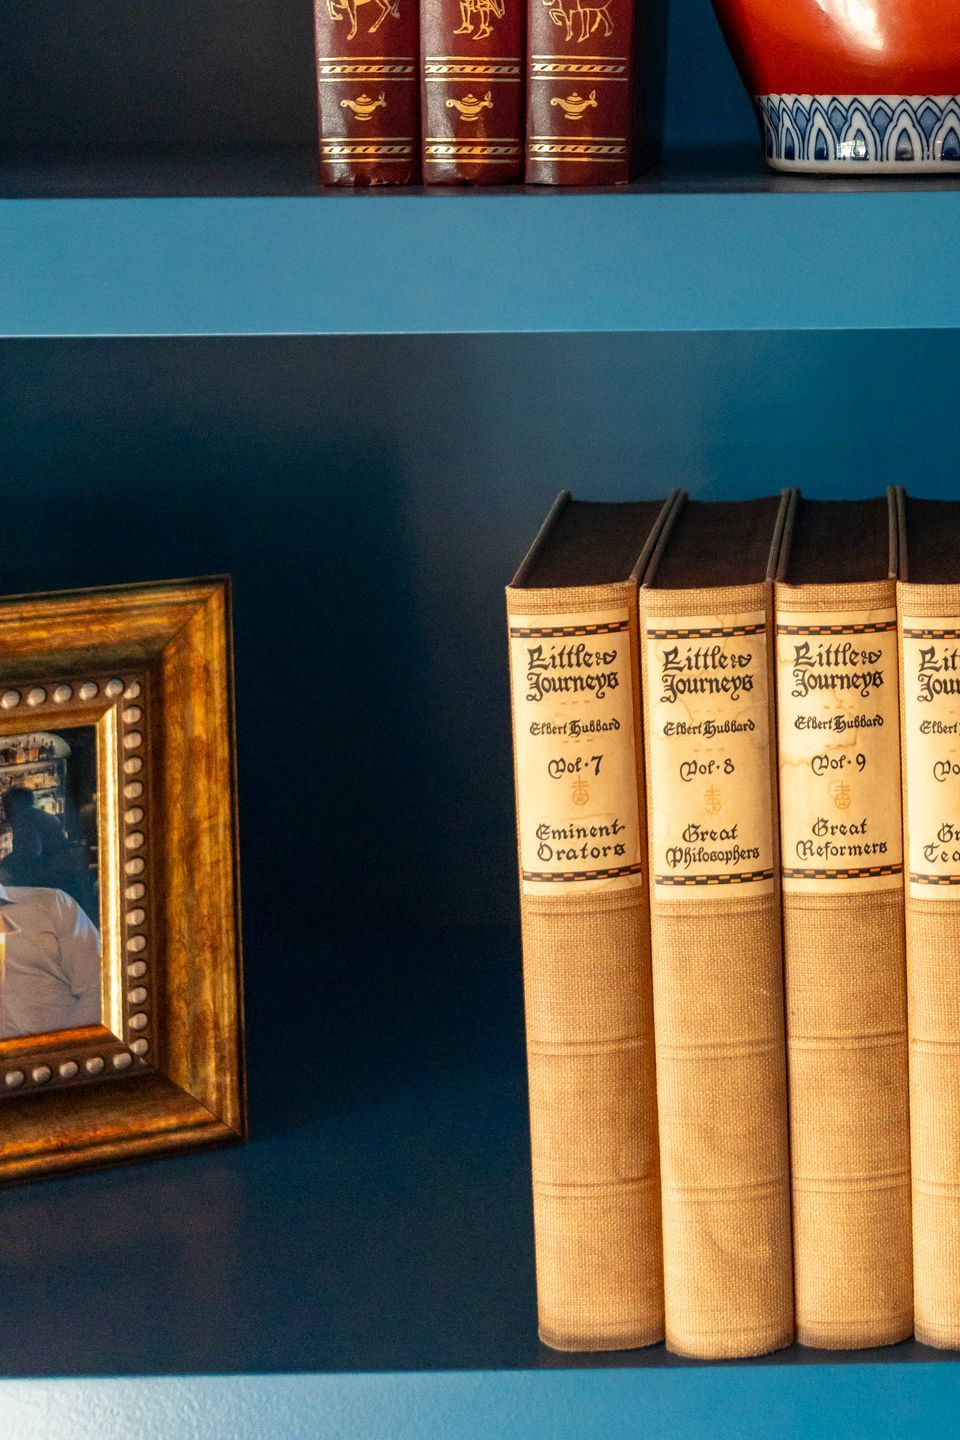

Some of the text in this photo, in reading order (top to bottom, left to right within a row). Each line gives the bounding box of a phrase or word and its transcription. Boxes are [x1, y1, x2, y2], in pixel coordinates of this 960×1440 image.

[527, 643, 594, 671] Little
[662, 646, 729, 673] Little
[793, 642, 860, 668] Little
[526, 671, 619, 702] Journeys
[660, 673, 754, 703] Journeys
[791, 668, 884, 697] Journeys
[530, 718, 621, 737] Elbert Hubbard
[663, 719, 755, 738] Elbert Hubbard
[794, 714, 884, 733] Elbert Hubbard
[920, 720, 958, 735] Elbert
[536, 818, 625, 841] Eminent
[682, 824, 738, 842] Great
[812, 817, 867, 836] Great
[537, 843, 626, 861] Orators
[665, 844, 760, 869] Philosophers
[796, 840, 888, 860] Reformers
